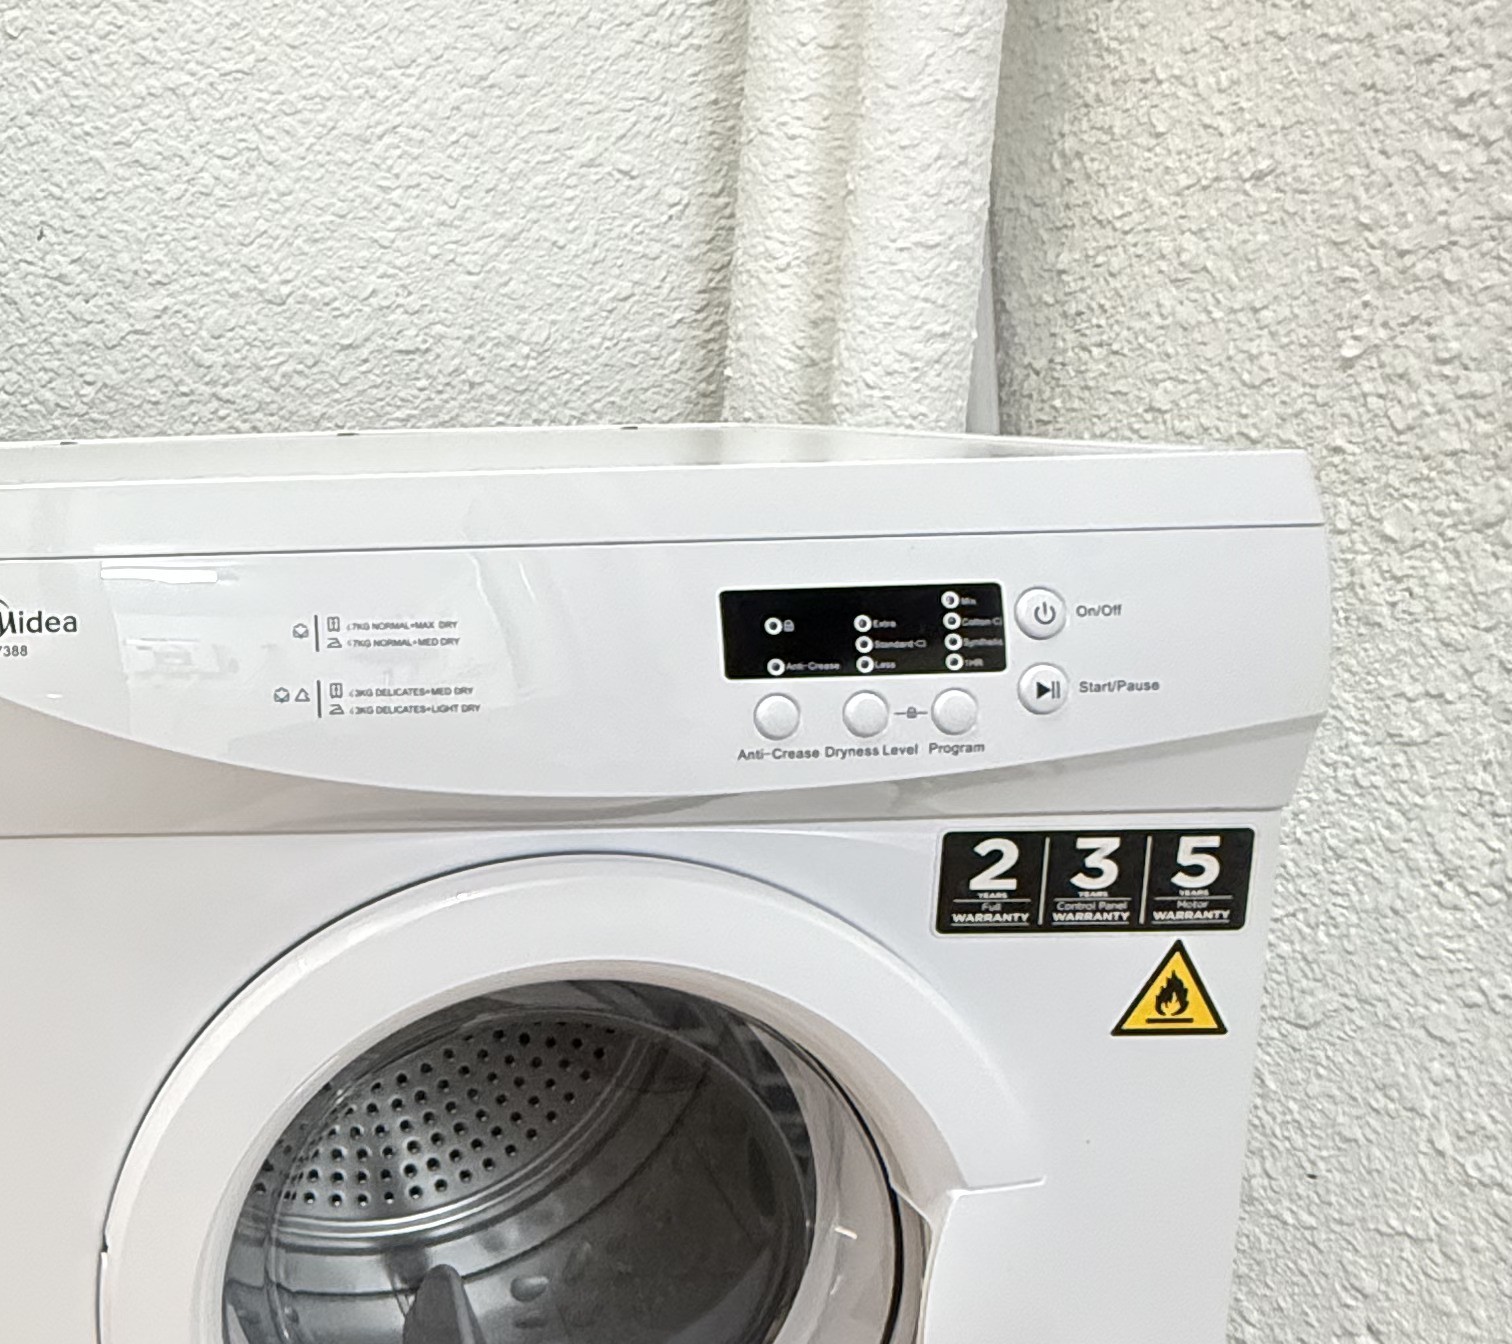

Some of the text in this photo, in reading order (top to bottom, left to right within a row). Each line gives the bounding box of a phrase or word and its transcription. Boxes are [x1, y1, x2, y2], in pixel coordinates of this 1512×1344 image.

[1076, 604, 1122, 617] On/Off
[438, 620, 459, 630] DRY
[440, 637, 461, 647] DRY
[454, 686, 474, 696] DRY
[1079, 680, 1160, 693] Start/Pause
[461, 704, 481, 713] DRY
[738, 747, 820, 760] Anti-Crease
[825, 743, 919, 760] Dryness Level
[929, 742, 985, 756] Program
[969, 838, 1019, 891] 2
[1069, 837, 1121, 890] 3
[1171, 835, 1221, 889] 5
[981, 901, 1002, 912] Full
[1057, 900, 1128, 911] Control Panel
[1176, 899, 1209, 909] Motor
[951, 912, 1030, 923] WARRANTY
[1052, 911, 1130, 922] WARRANTY
[1153, 909, 1230, 921] WARRANTY
